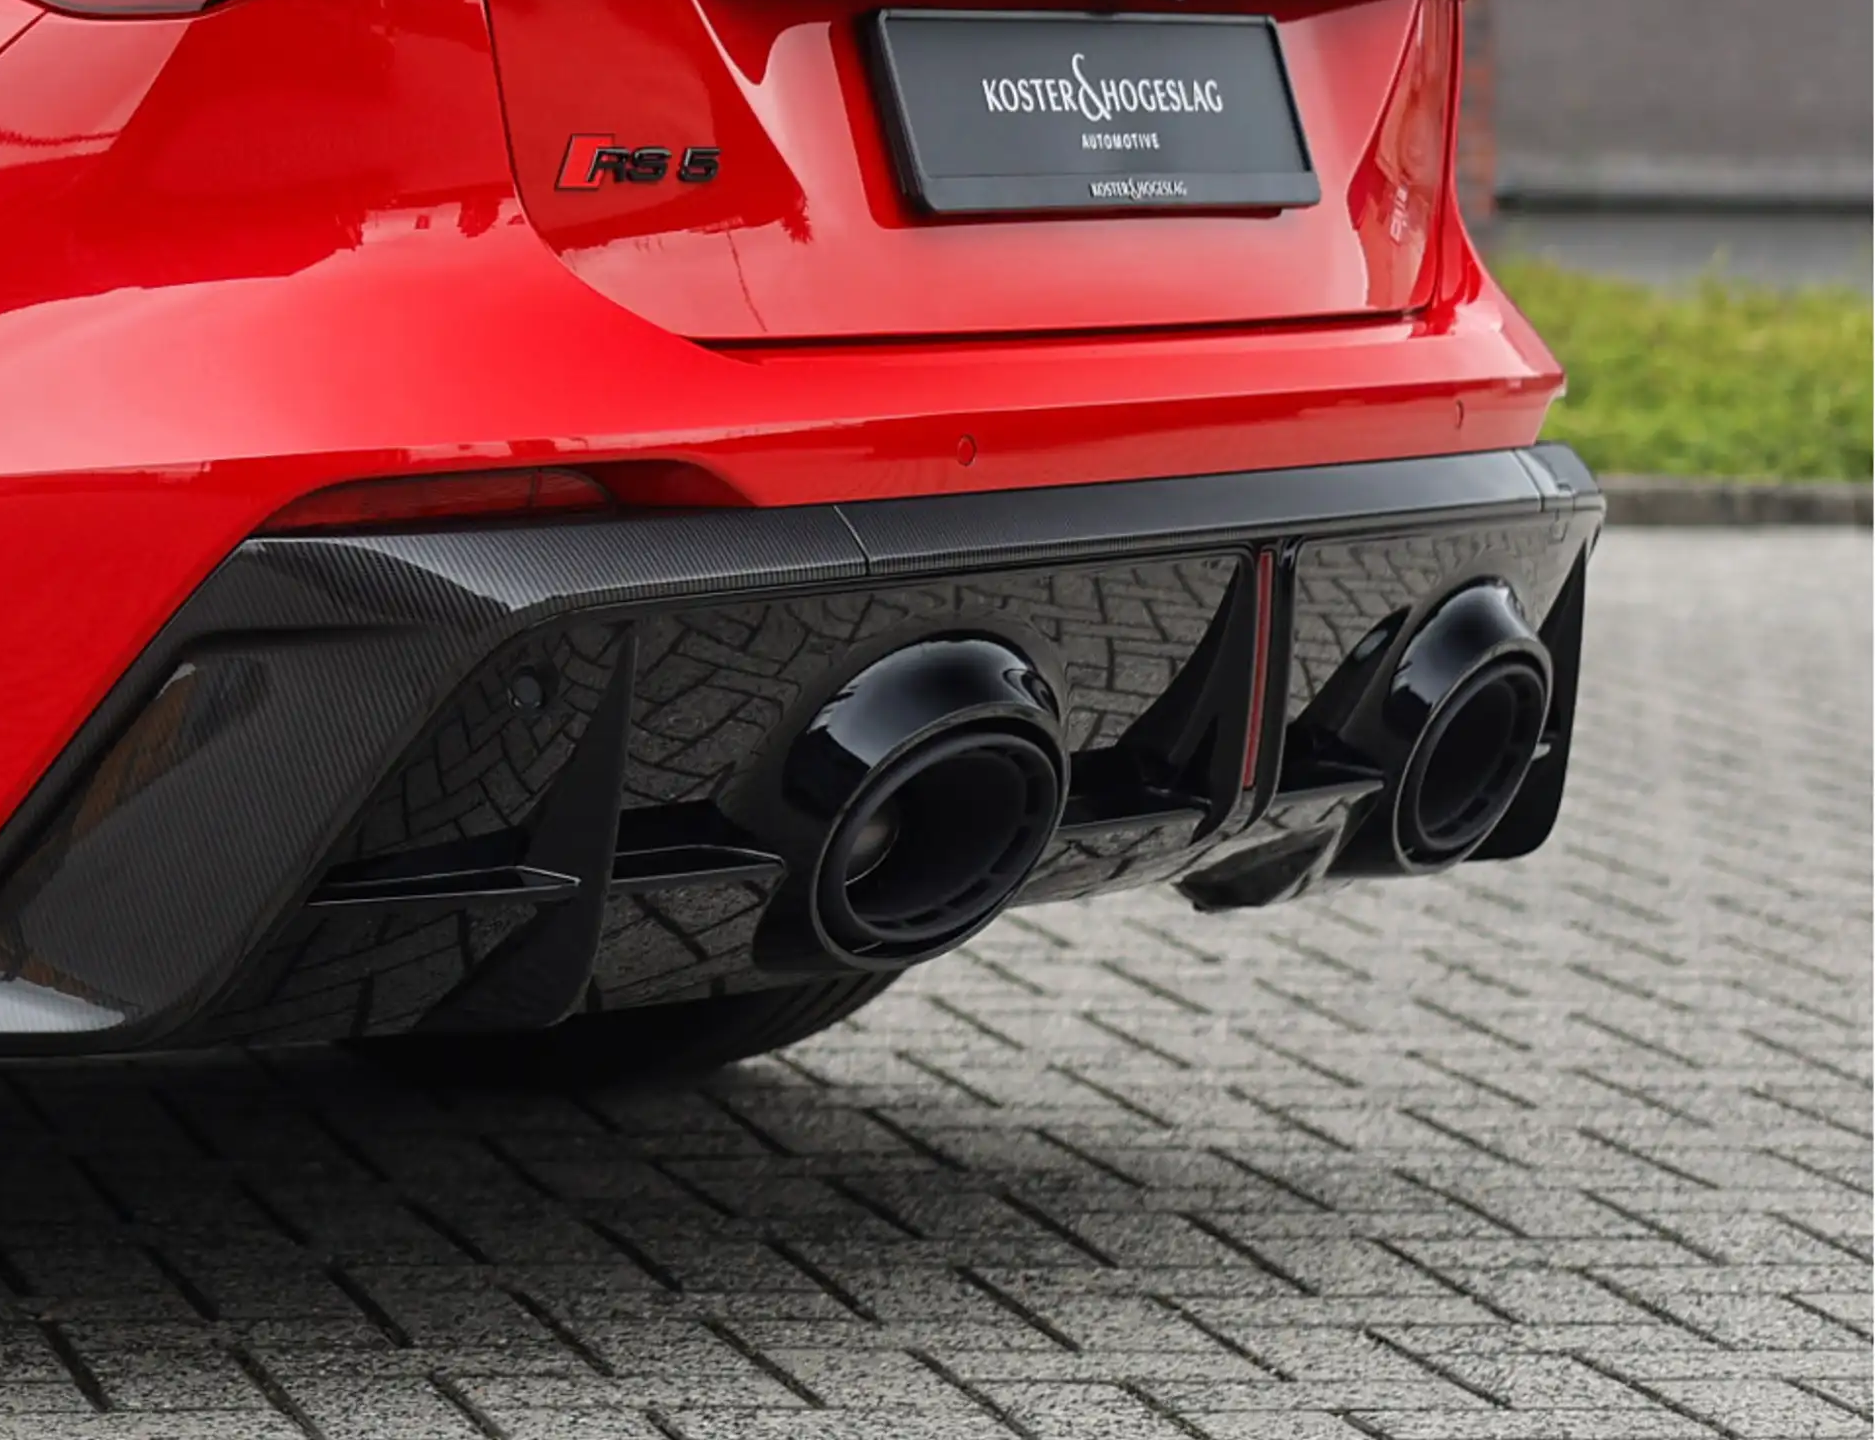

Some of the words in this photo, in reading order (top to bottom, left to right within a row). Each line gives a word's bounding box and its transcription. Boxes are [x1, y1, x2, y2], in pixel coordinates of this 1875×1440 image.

[1081, 132, 1161, 151] AUTOMOTIVE
[585, 146, 672, 183] RS
[678, 146, 721, 183] 5
